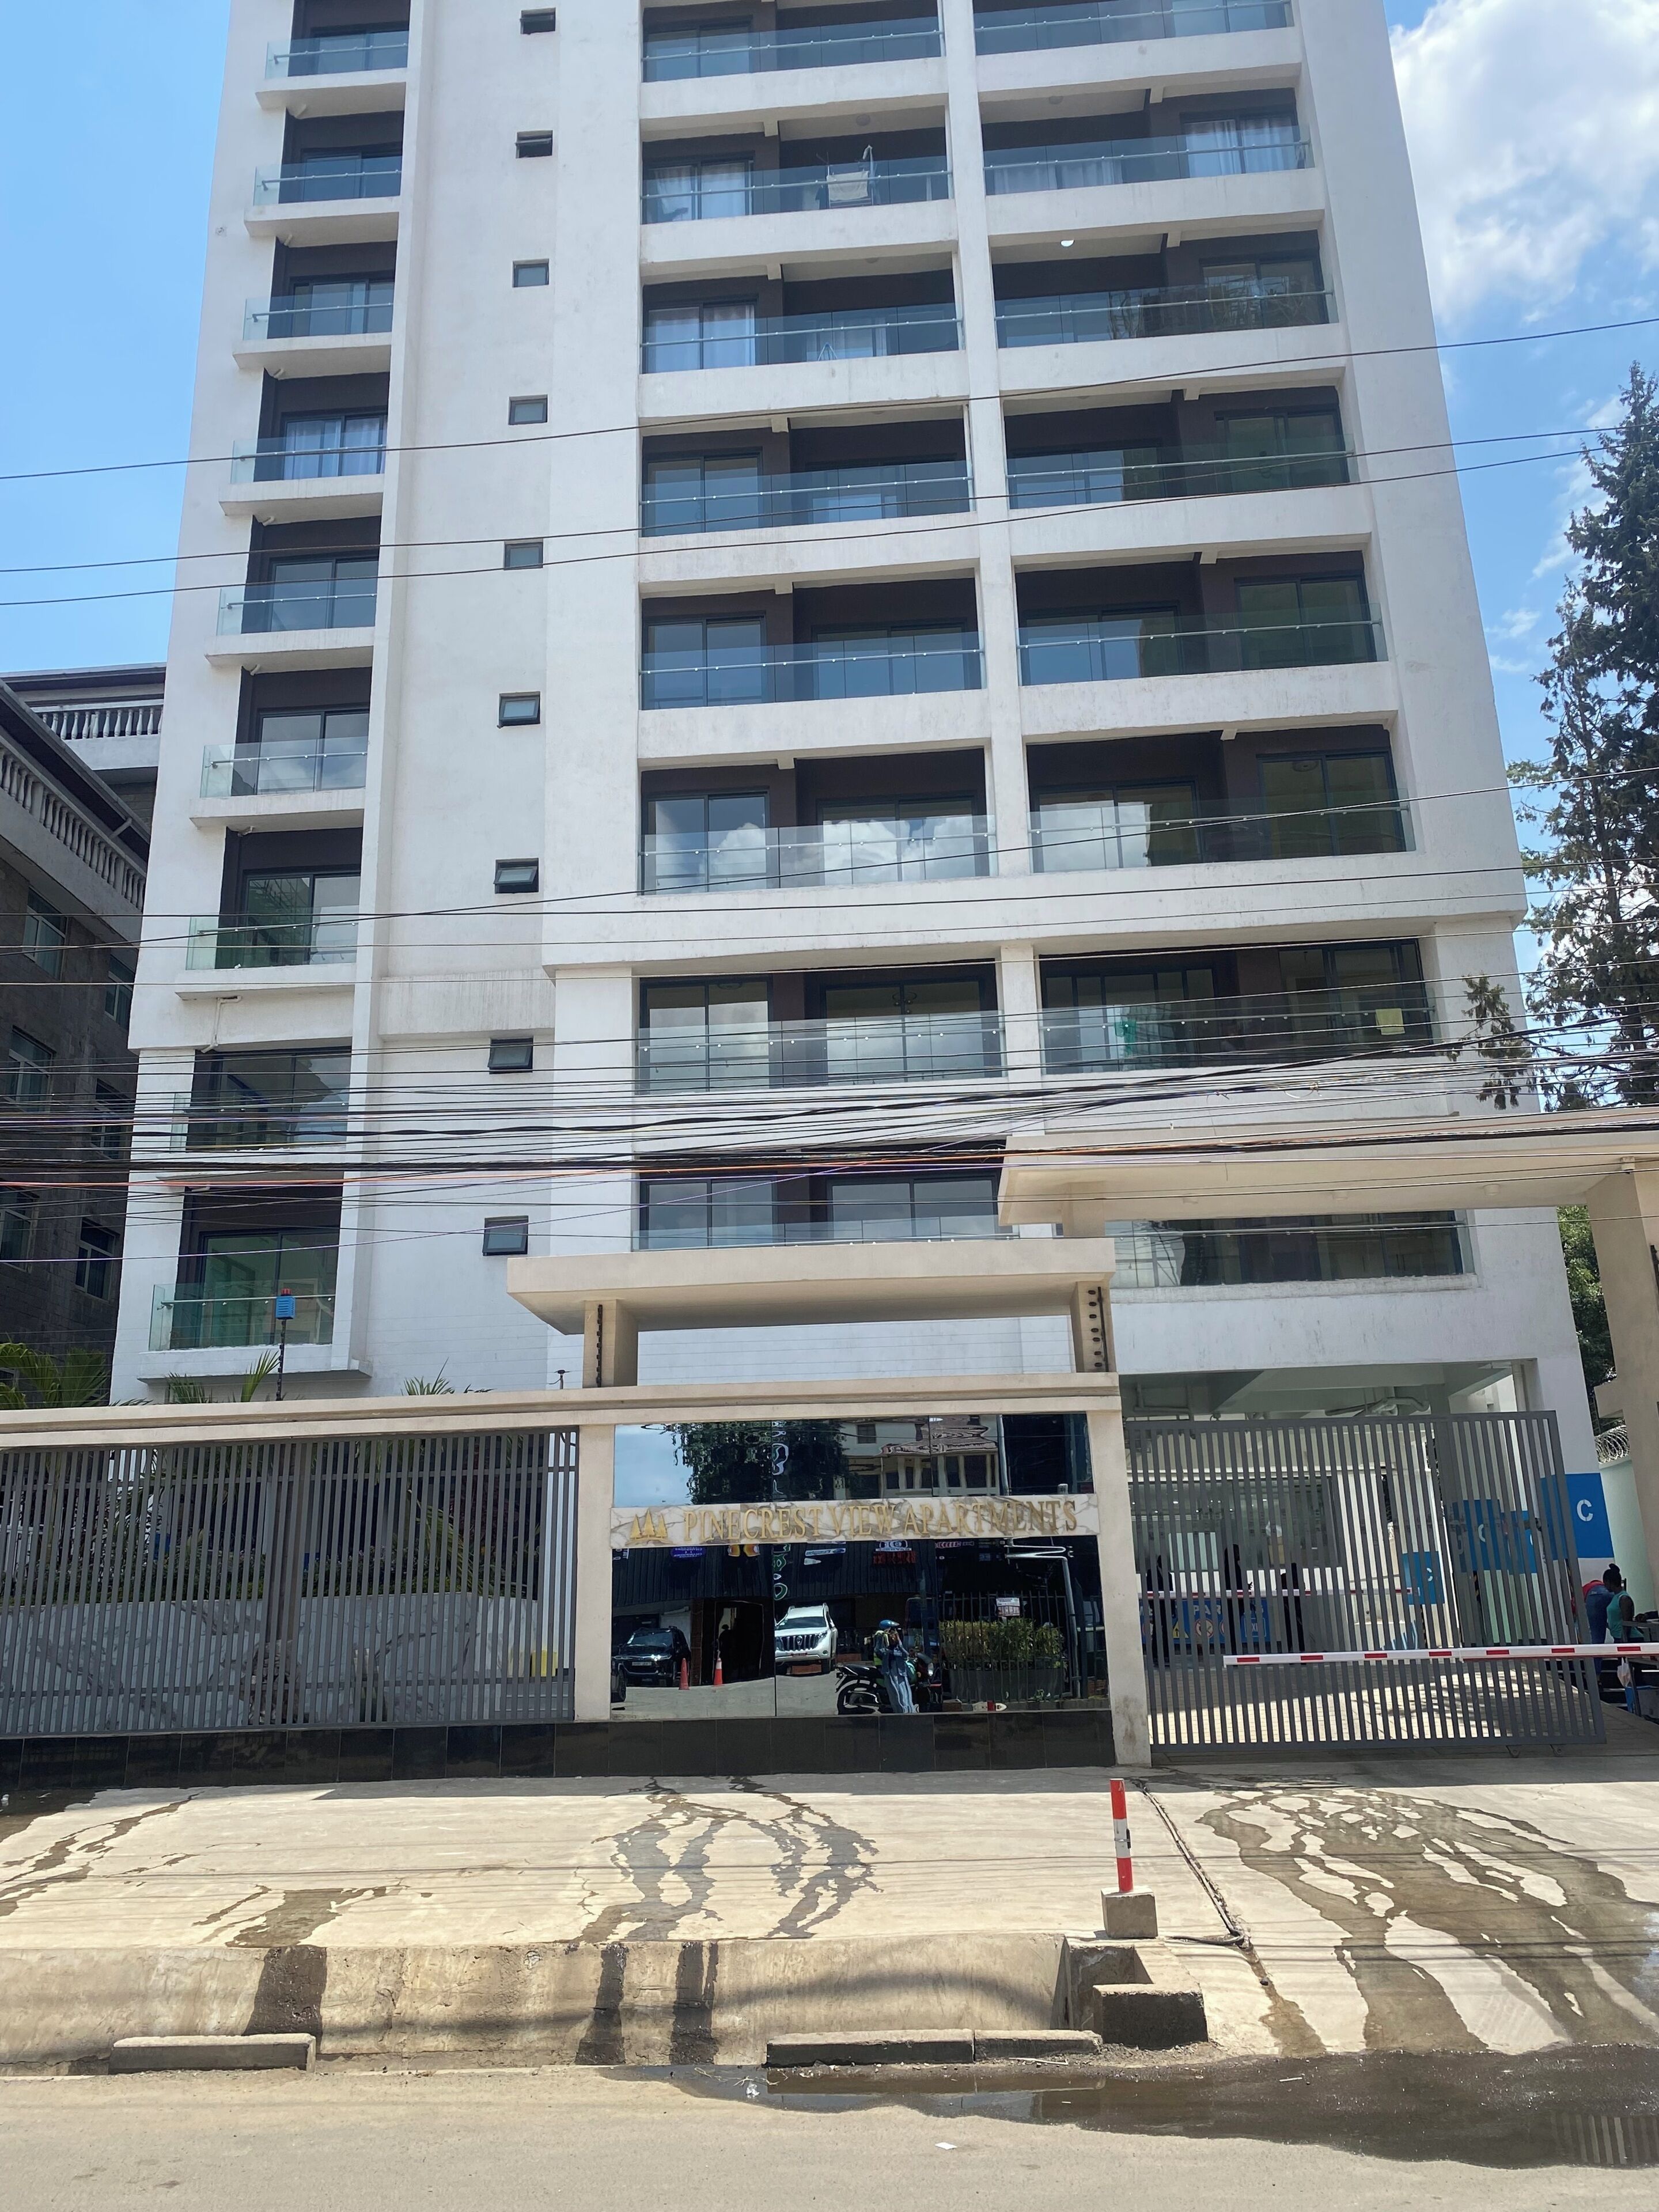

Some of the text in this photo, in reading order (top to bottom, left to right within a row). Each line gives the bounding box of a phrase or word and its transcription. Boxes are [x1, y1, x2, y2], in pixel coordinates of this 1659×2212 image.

[684, 1500, 1077, 1541] PINECREST VIEW APARTMENTS
[1577, 1499, 1594, 1522] C
